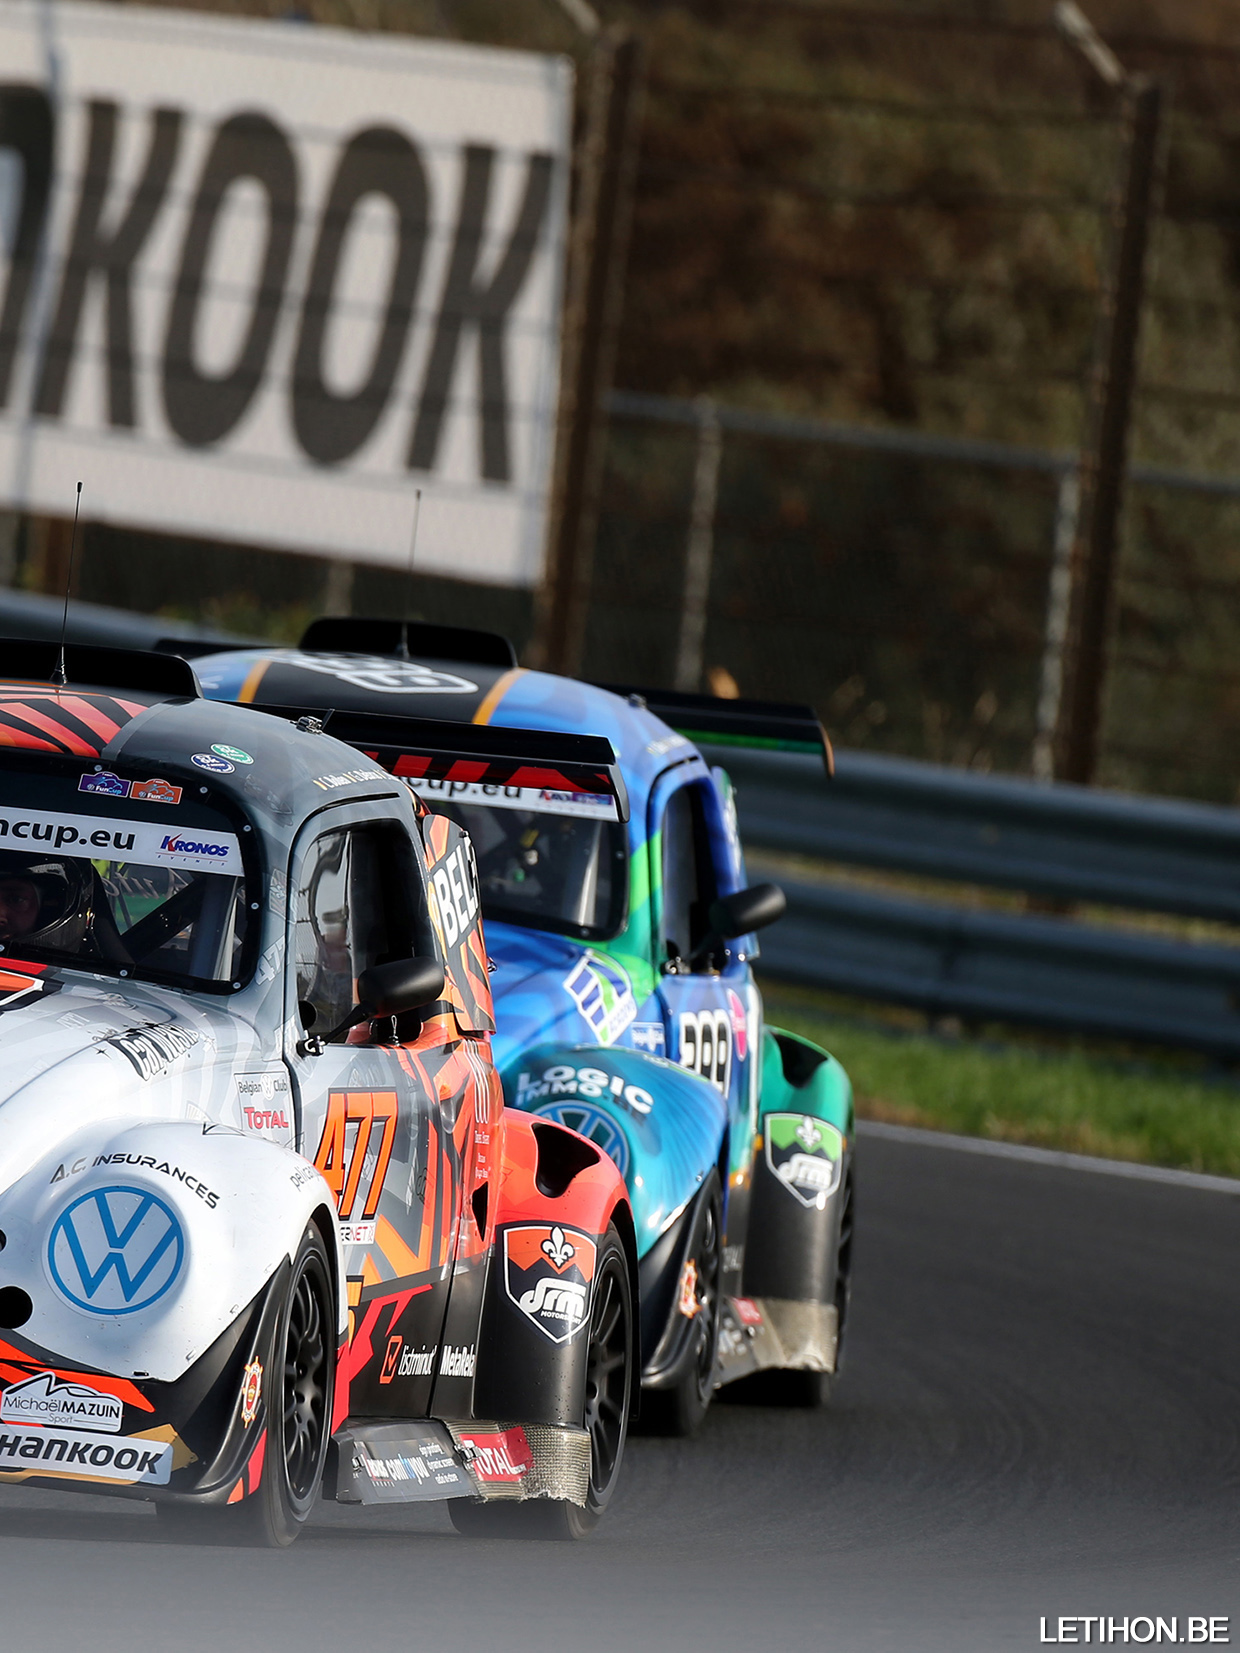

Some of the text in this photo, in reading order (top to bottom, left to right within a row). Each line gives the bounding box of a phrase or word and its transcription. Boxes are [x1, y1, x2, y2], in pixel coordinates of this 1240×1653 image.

[160, 832, 230, 857] KRONOS
[238, 1081, 263, 1096] Belgian
[273, 1079, 288, 1092] Club
[517, 1065, 655, 1115] LOGIC
[243, 1107, 290, 1130] TOTAL
[312, 1091, 399, 1222] 477
[49, 1152, 221, 1210] A.C. INSURANCES
[3, 1395, 121, 1419] Michaël MAZUIN
[48, 1412, 74, 1425] Sport
